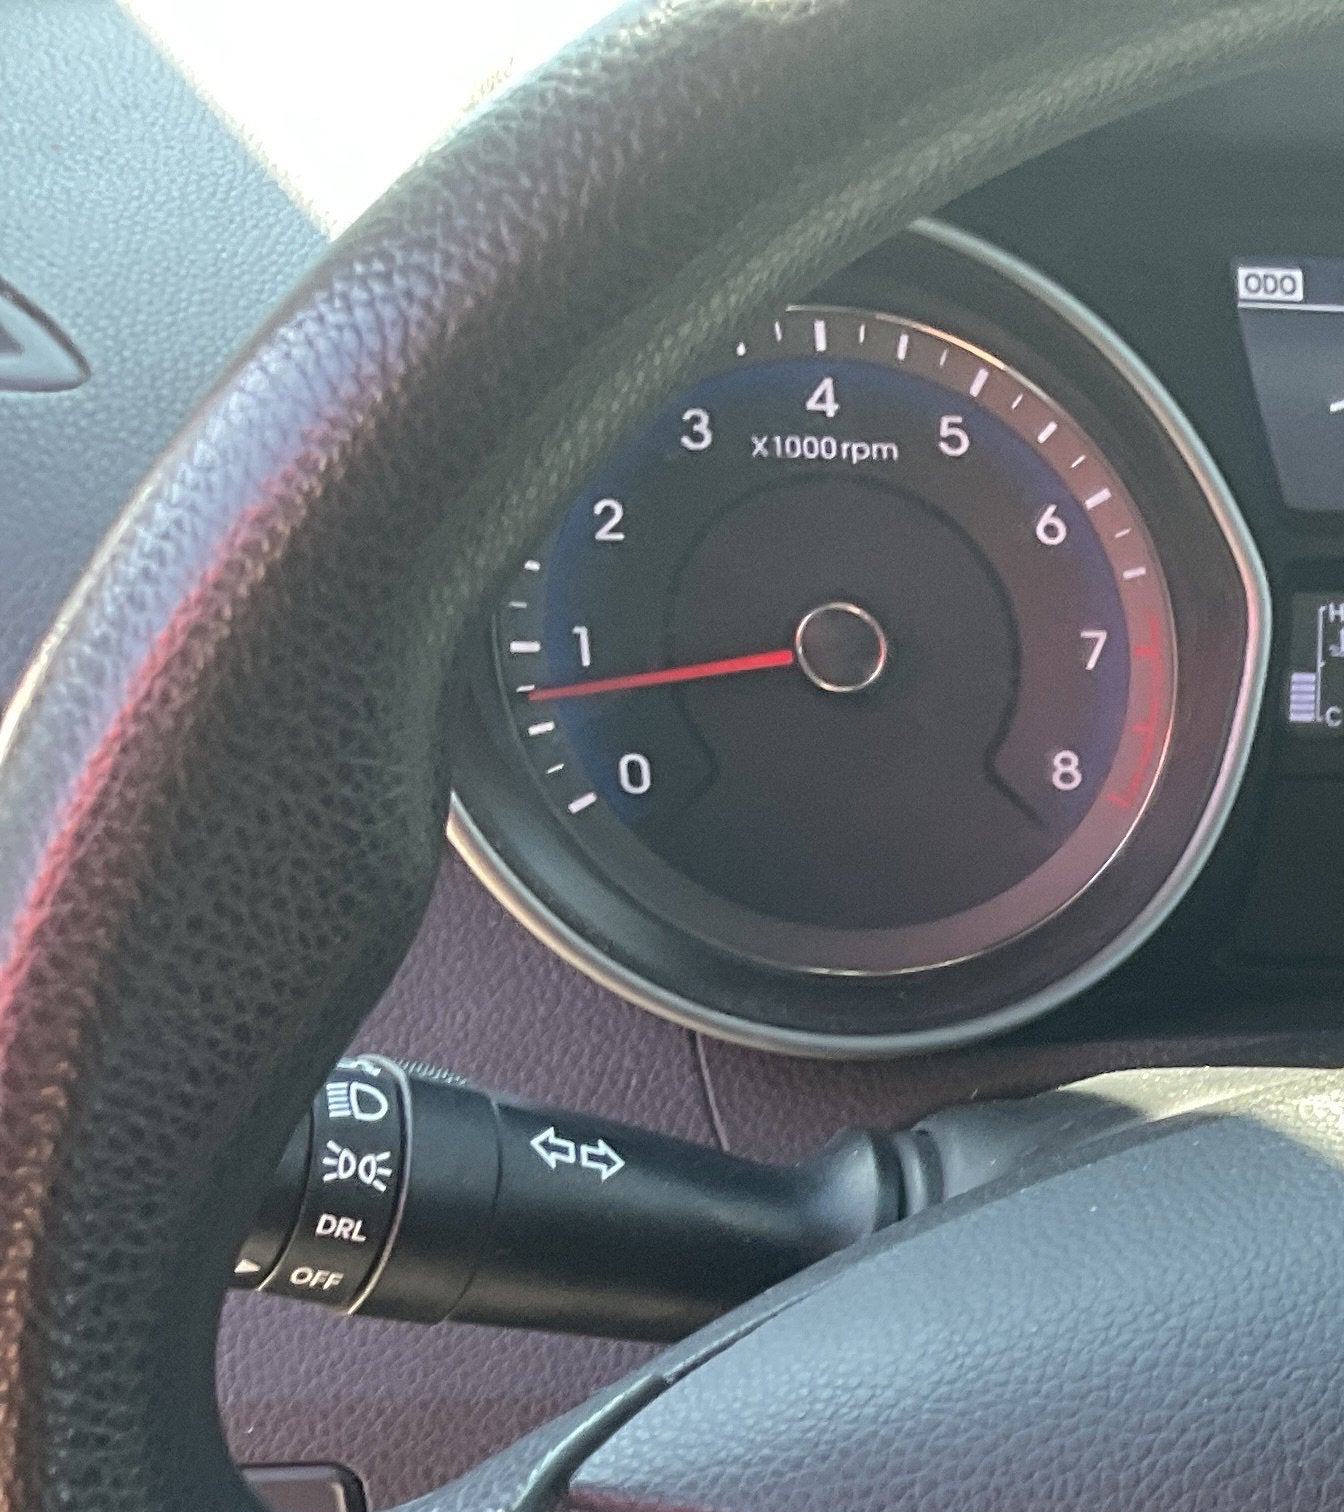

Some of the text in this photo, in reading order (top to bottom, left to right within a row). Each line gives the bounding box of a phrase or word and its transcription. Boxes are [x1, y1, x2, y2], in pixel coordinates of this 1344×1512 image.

[1244, 272, 1297, 296] ODO
[805, 377, 839, 418] 4
[680, 409, 712, 451] 3
[938, 415, 970, 456] 5
[593, 499, 625, 542] 2
[1035, 504, 1067, 546] 6
[573, 626, 592, 667] 1
[1079, 629, 1107, 671] 7
[1325, 706, 1342, 727] C
[618, 753, 652, 795] 0
[1050, 751, 1082, 792] 8
[315, 1213, 366, 1242] DRL
[290, 1267, 344, 1290] OFF
